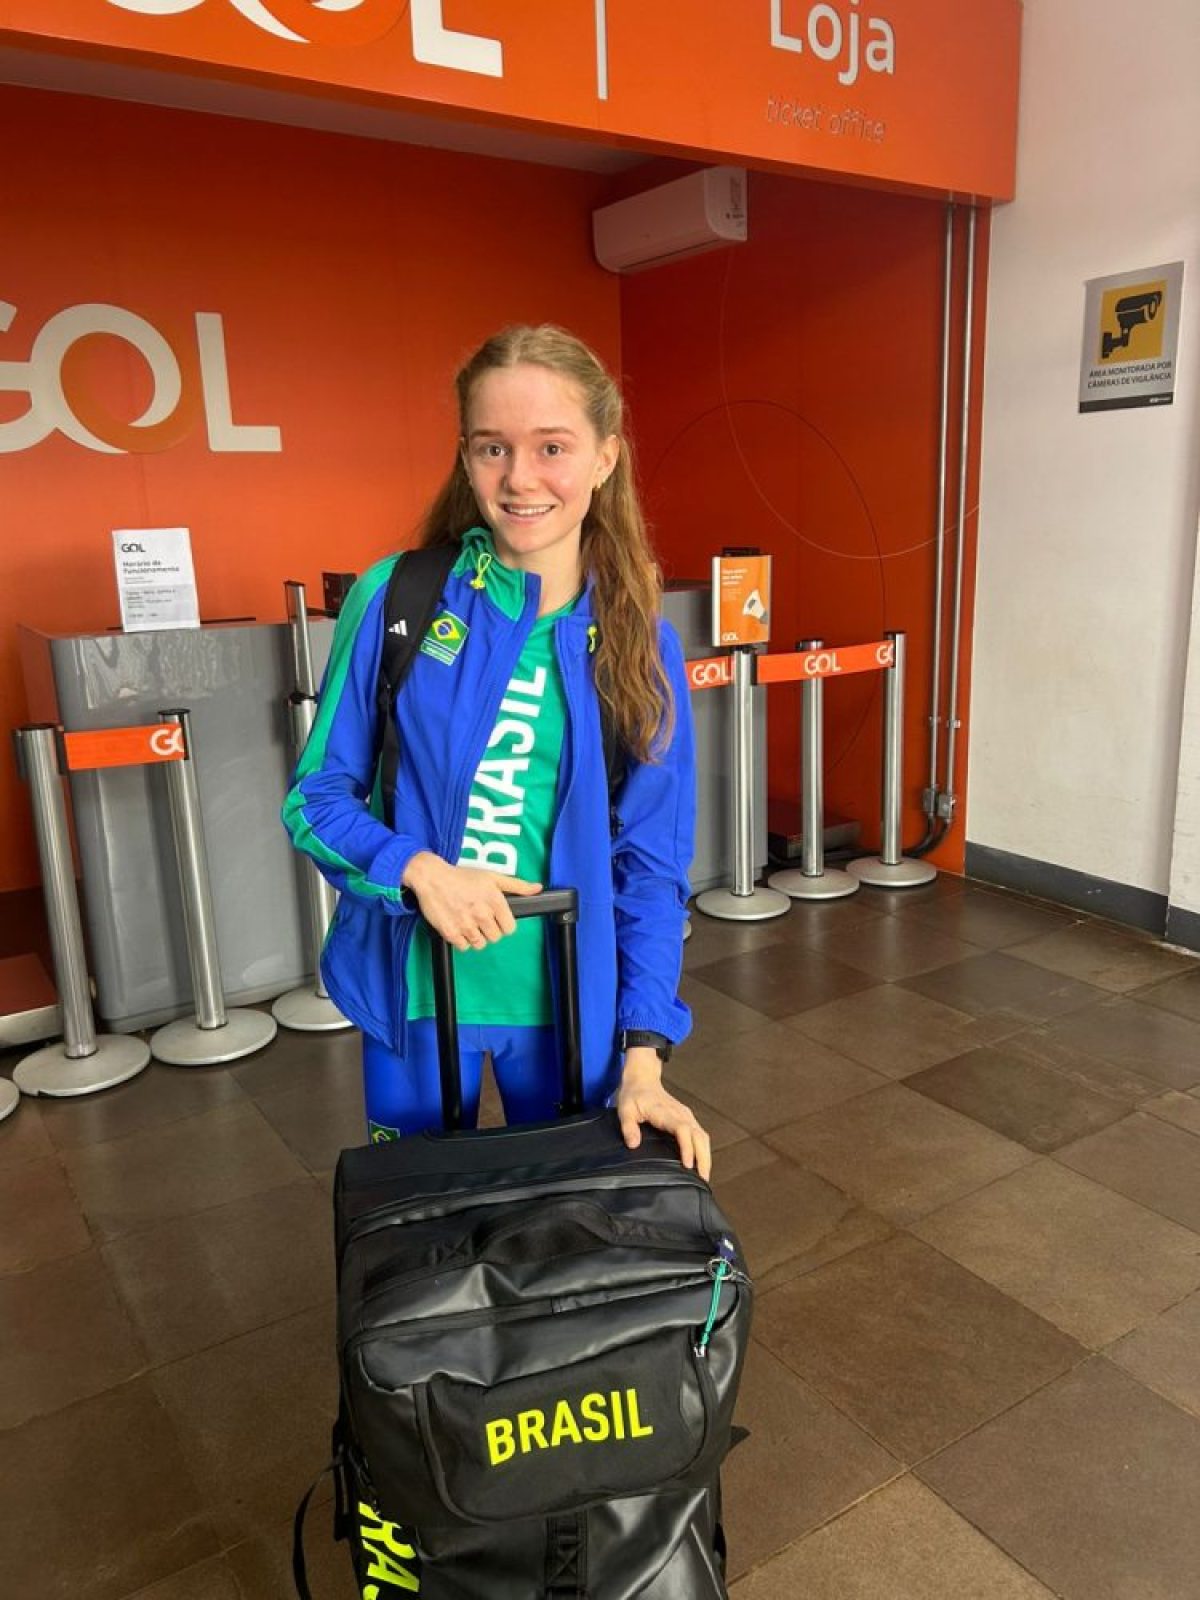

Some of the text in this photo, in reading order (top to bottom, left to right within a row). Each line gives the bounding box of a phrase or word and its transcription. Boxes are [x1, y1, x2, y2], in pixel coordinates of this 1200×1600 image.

[770, 0, 896, 86] Loja
[767, 95, 886, 143] ticket office
[1121, 377, 1131, 385] DE
[121, 543, 147, 553] GOL
[692, 662, 732, 686] GOL
[804, 652, 842, 676] GOL
[456, 665, 547, 877] BRASIL
[485, 1388, 653, 1466] BRASIL
